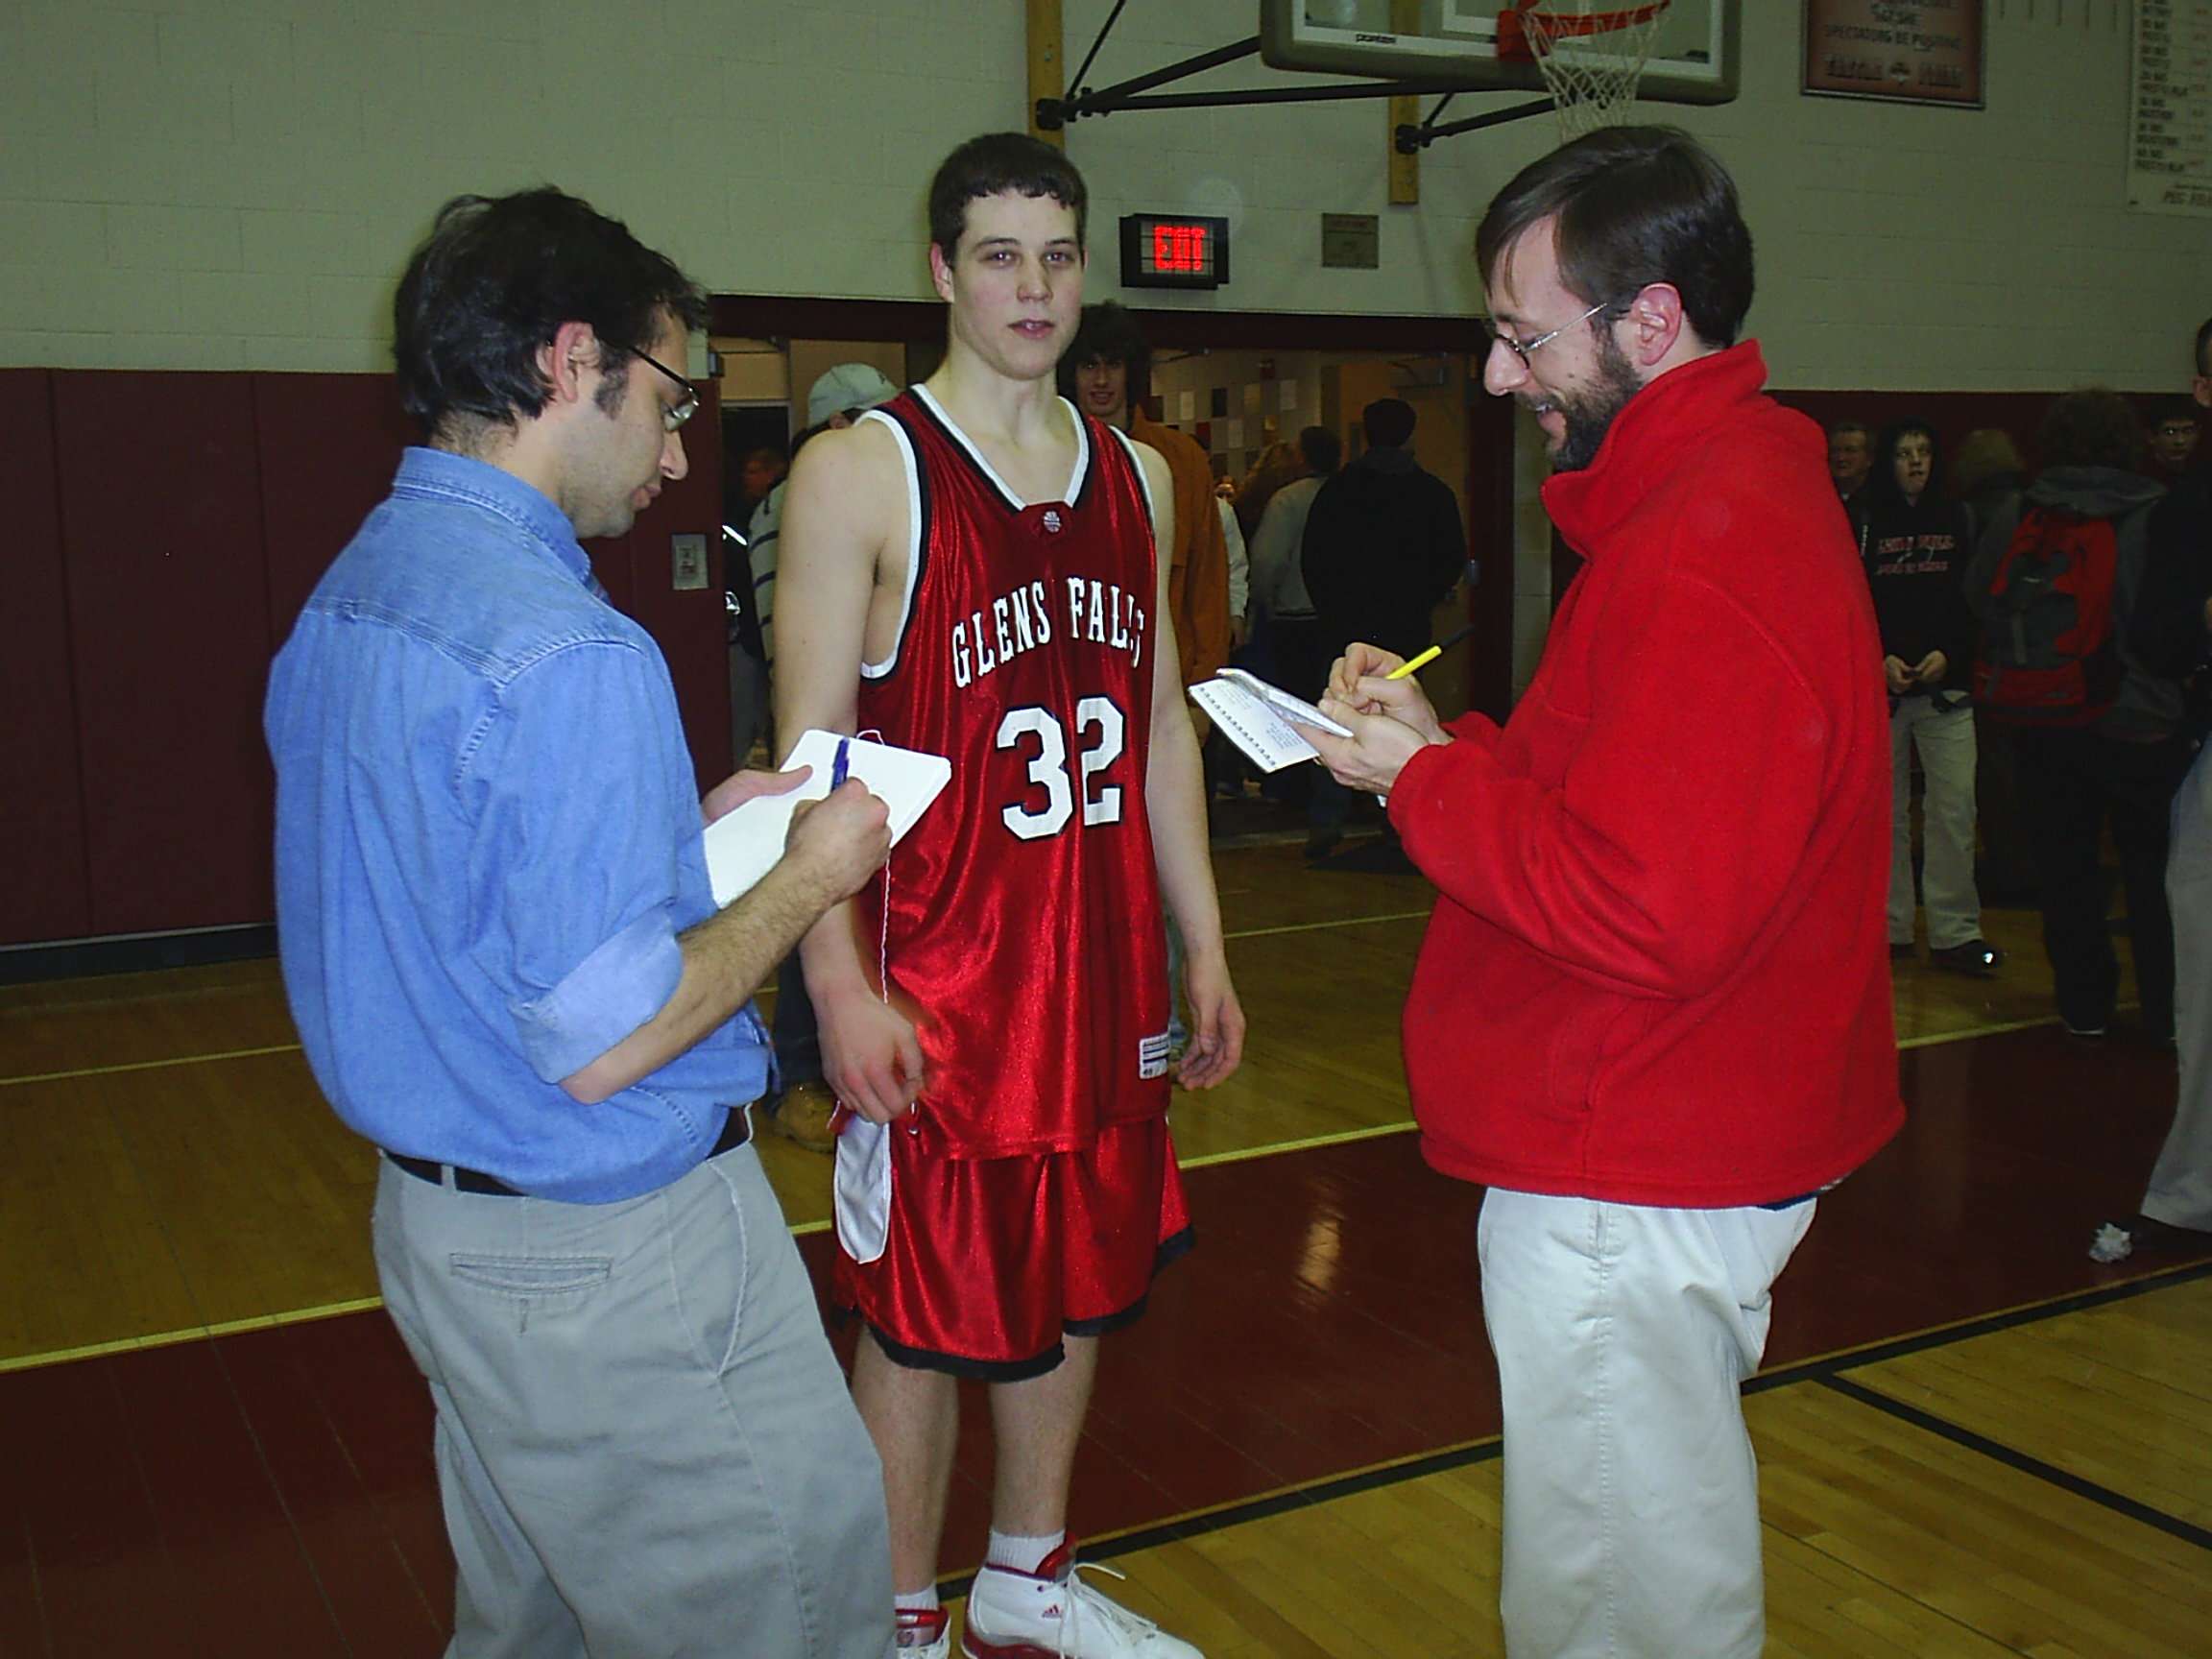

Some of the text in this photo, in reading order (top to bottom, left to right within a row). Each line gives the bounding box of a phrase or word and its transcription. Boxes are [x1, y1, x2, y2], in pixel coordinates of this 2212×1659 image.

[1154, 226, 1207, 271] EXIT
[951, 579, 1053, 688] GLENS
[996, 696, 1124, 841] 32
